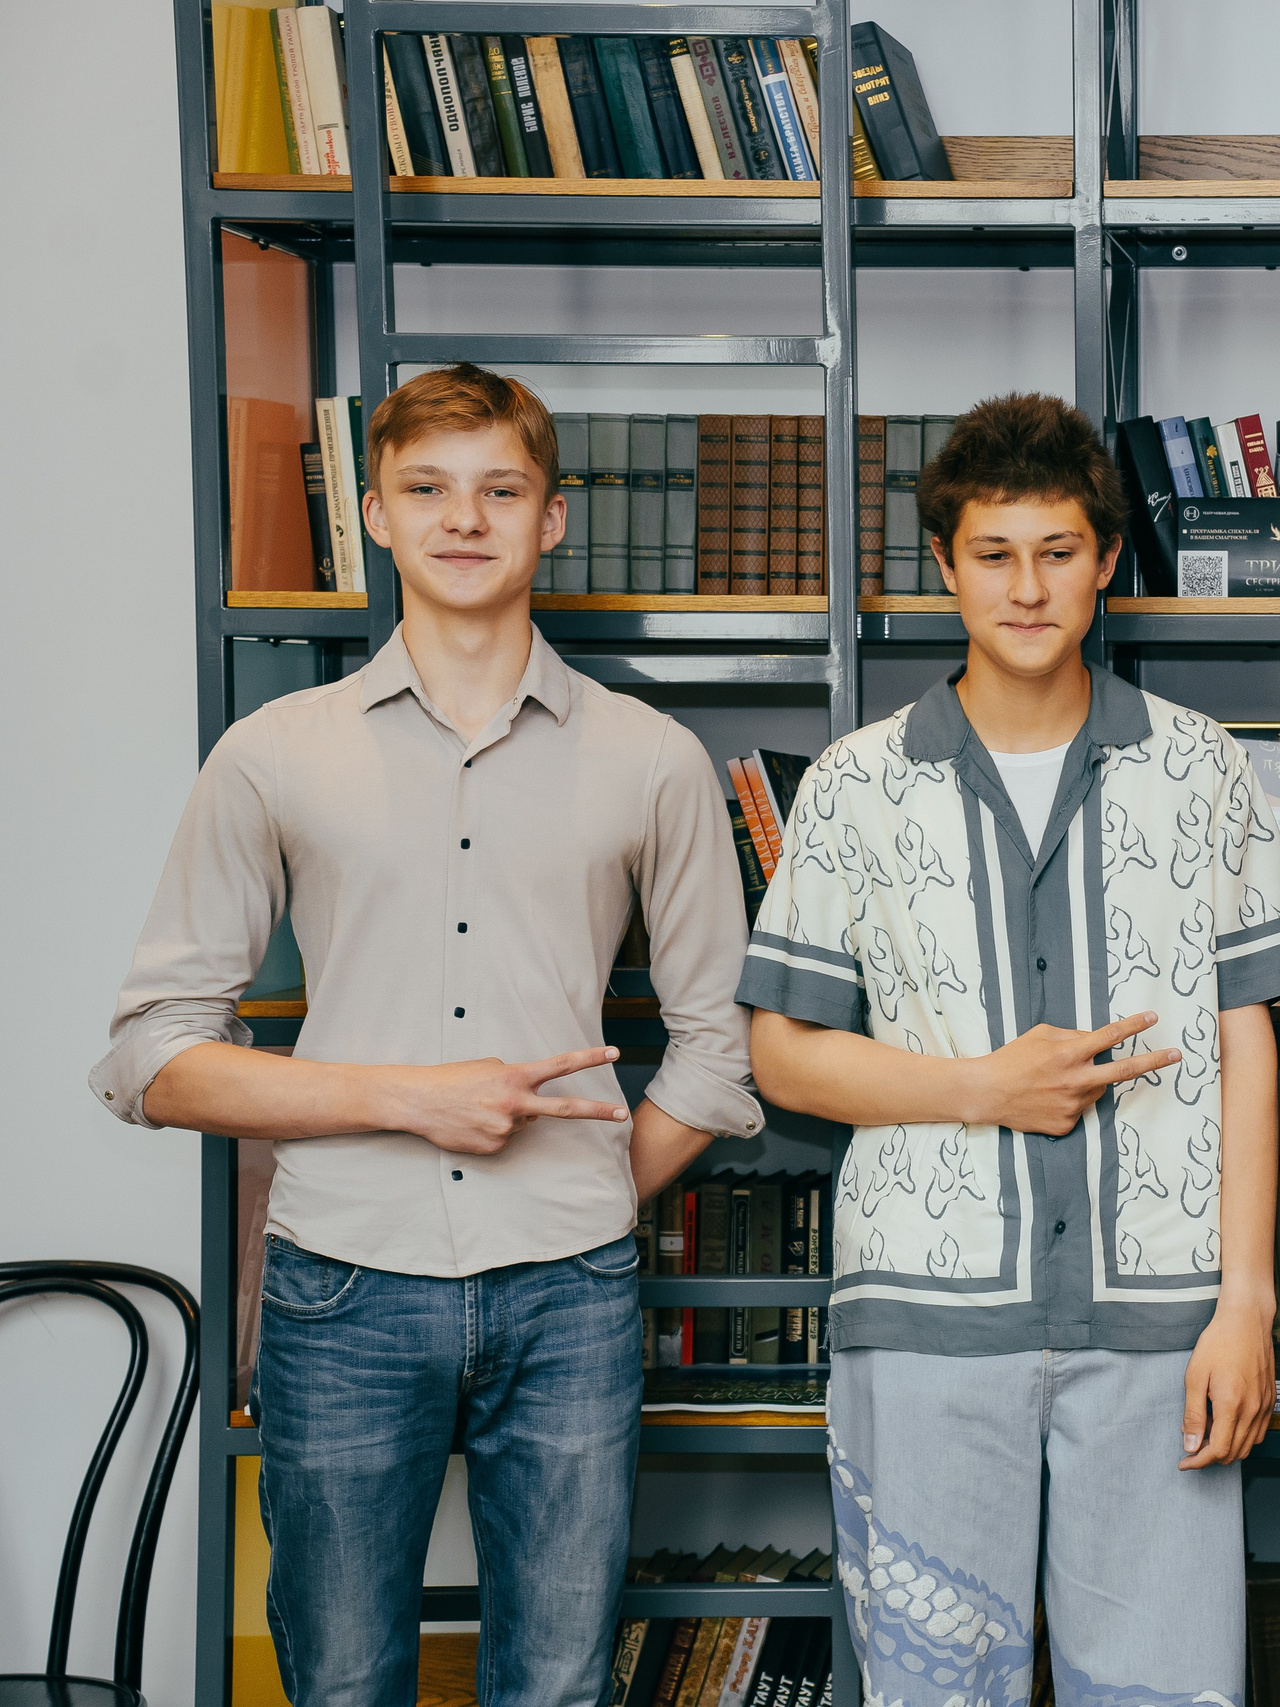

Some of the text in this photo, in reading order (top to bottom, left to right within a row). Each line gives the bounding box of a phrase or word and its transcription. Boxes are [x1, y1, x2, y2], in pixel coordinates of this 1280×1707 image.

[852, 64, 884, 79] ЗВЕЗДЫ
[855, 76, 890, 94] СМОТРЯТ
[510, 56, 539, 132] БОРИС ПОЛЕВОЙ
[867, 92, 890, 107] ВНИЗ
[773, 92, 798, 142] БРАТСТВА
[750, 824, 774, 870] МАСКА
